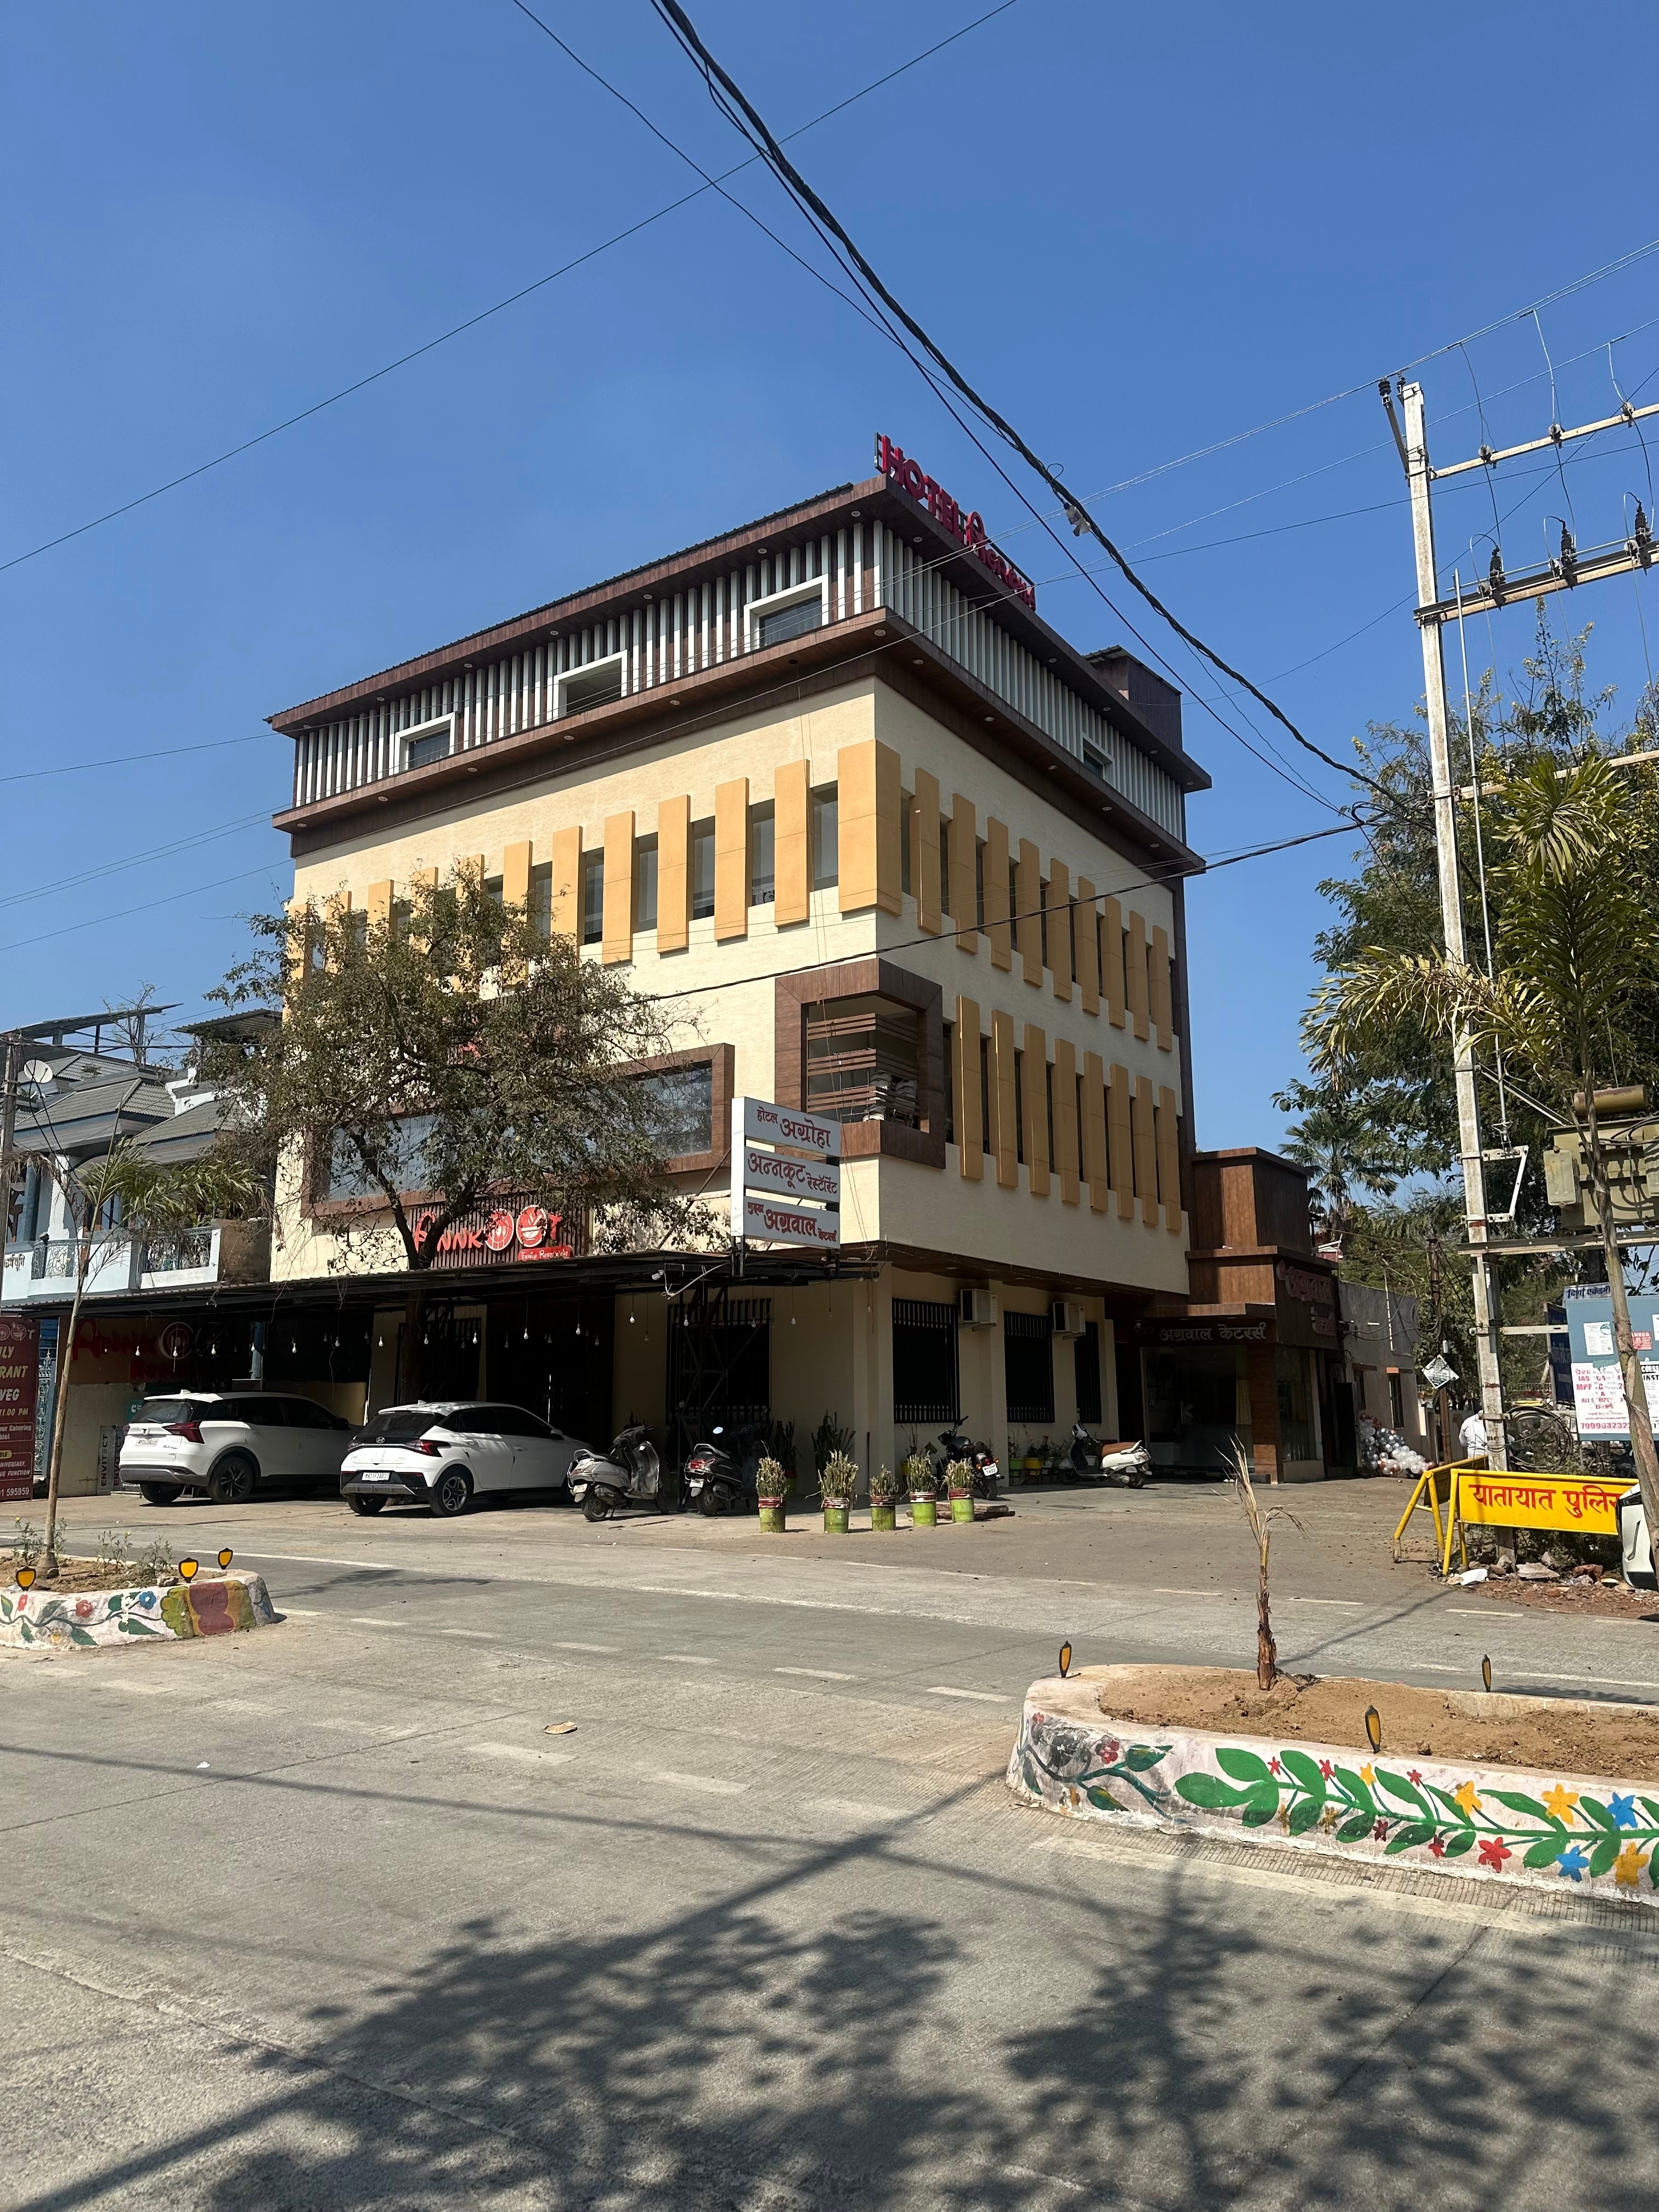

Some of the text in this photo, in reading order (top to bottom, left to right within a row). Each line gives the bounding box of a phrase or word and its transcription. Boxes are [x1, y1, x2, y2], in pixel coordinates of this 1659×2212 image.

[881, 435, 967, 542] HOTEL
[757, 1106, 831, 1148] होटल अग्रोहा
[748, 1153, 805, 1189] अन्नकूट
[764, 1209, 817, 1237] अग्रवाल
[1159, 1327, 1213, 1341] अग्रवाल
[18, 1408, 29, 1416] PM
[7, 1487, 29, 1497] 595959
[1469, 1484, 1556, 1510] यातायात
